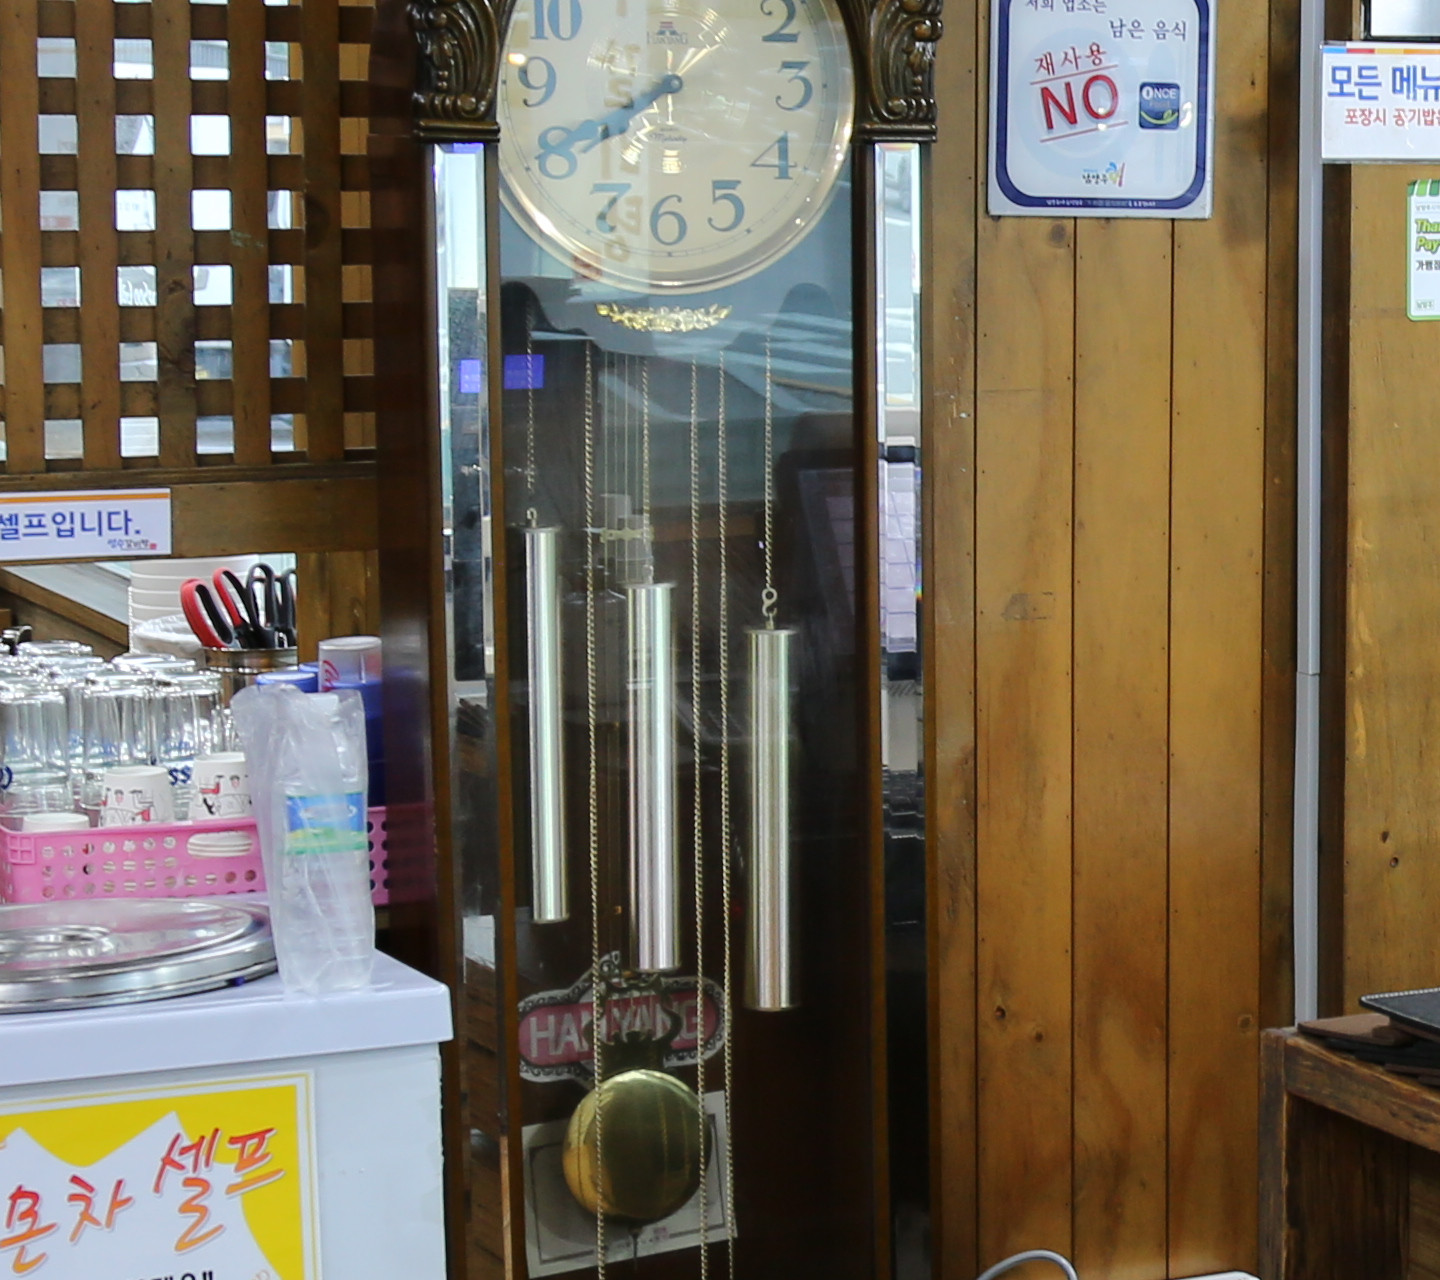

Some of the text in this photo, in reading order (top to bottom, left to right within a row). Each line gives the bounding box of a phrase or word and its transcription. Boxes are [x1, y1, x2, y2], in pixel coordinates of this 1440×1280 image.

[1109, 18, 1188, 41] 남은 음식
[518, 57, 556, 107] 9
[1035, 42, 1107, 76] 재사용
[1327, 65, 1382, 100] 모든
[776, 61, 813, 111] 3
[1040, 74, 1119, 129] NO
[1344, 108, 1387, 127] 포장시
[535, 126, 578, 179] 8
[750, 131, 797, 179] 4
[590, 183, 631, 233] 7
[650, 195, 687, 245] 6
[708, 180, 745, 231] 5
[154, 1128, 285, 1252] 셀프
